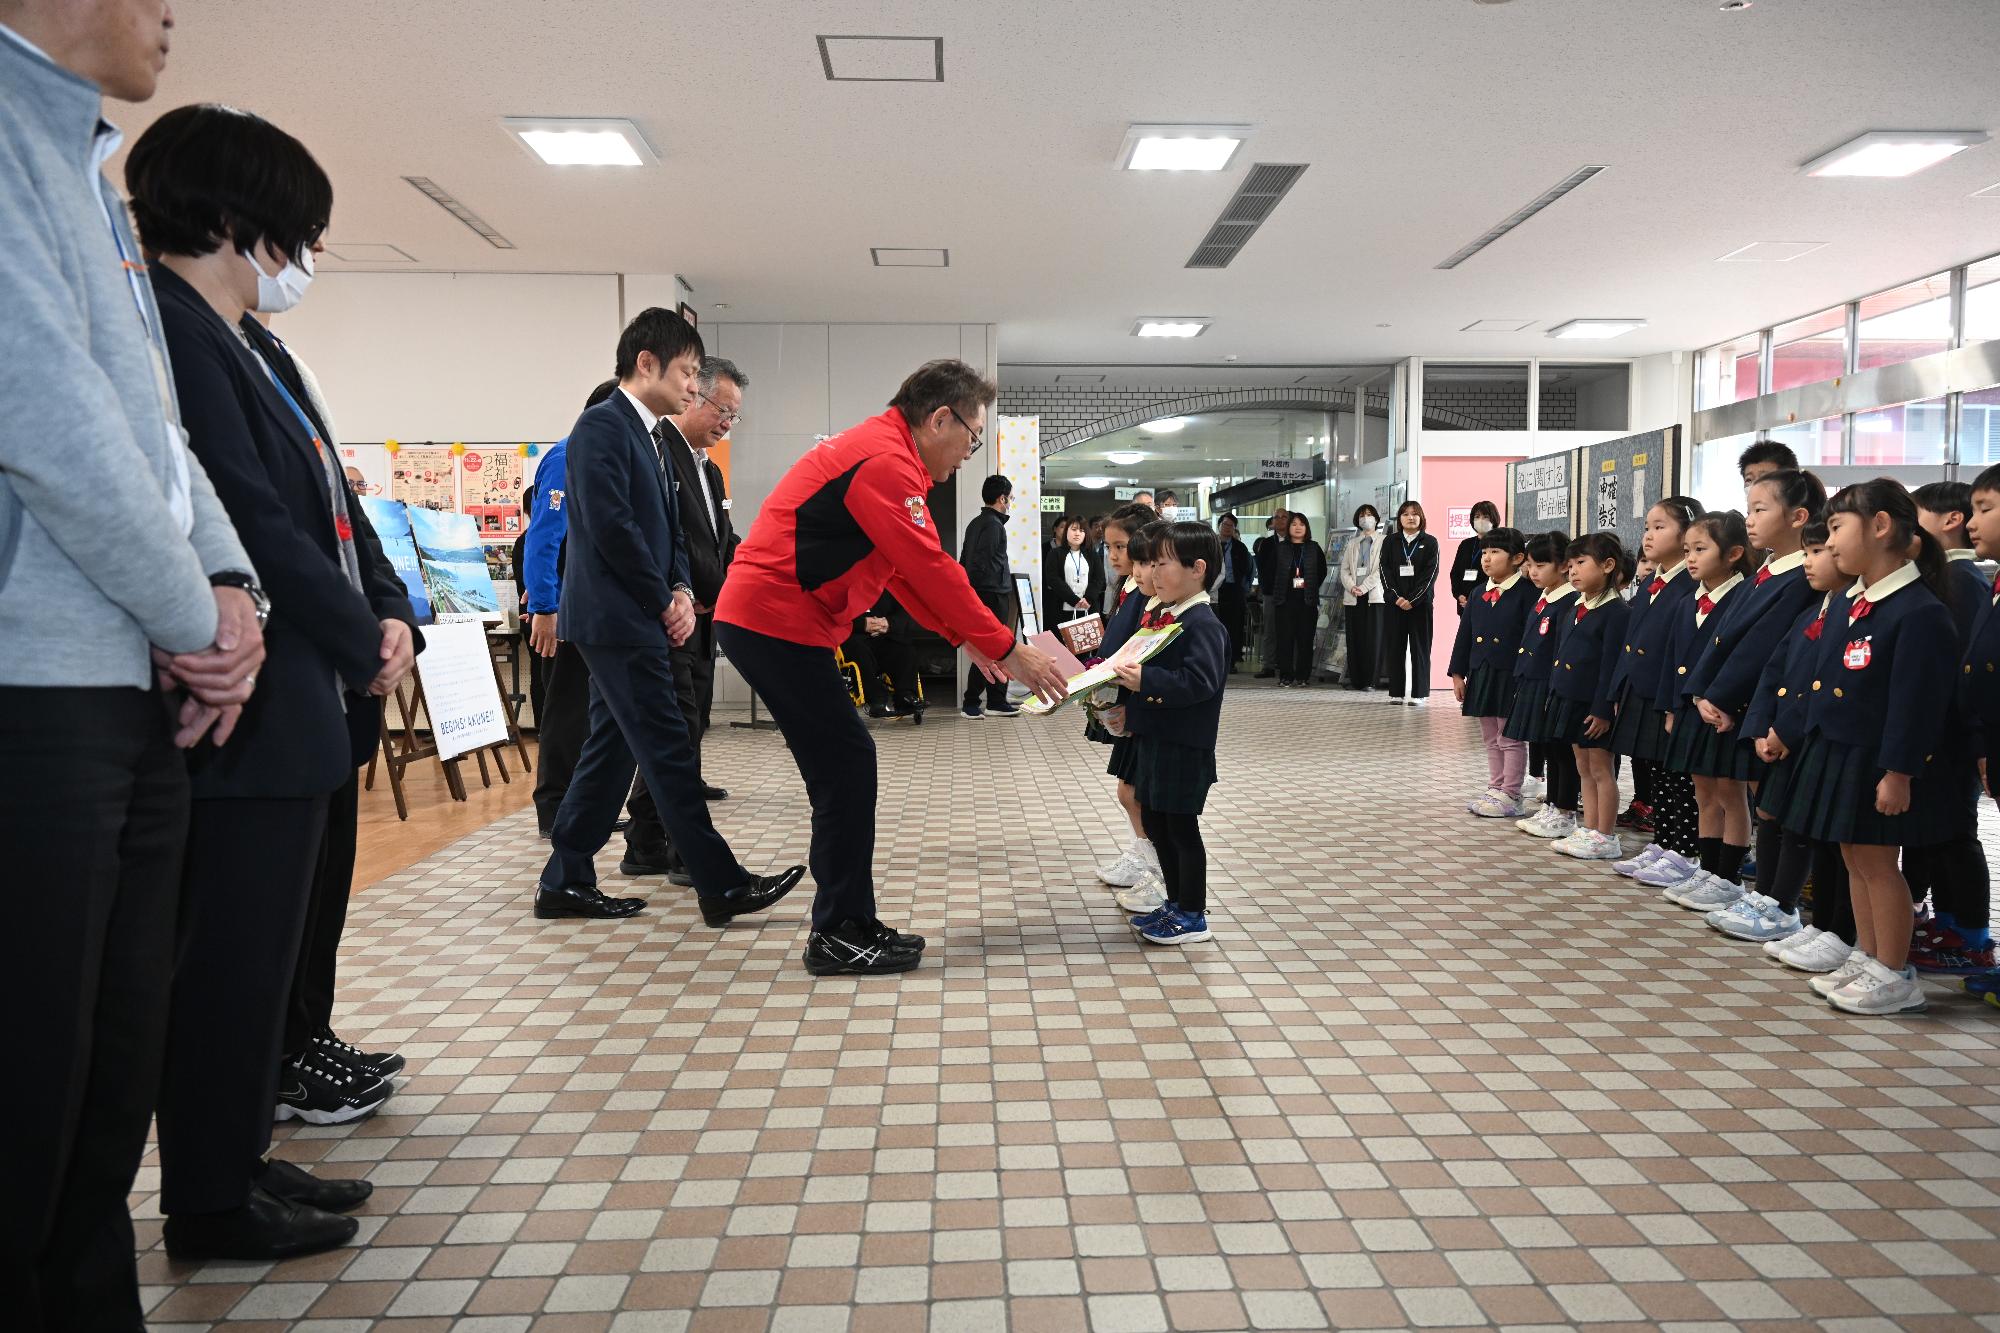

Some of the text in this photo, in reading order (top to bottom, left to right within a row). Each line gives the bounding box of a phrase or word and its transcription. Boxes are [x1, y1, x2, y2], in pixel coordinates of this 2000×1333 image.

[482, 455, 493, 488] つどい
[494, 452, 508, 480] 福祉
[1261, 459, 1290, 468] 阿久根市
[1261, 470, 1313, 479] 消費生活センター
[1518, 465, 1563, 490] 税に関する
[1538, 494, 1567, 517] 作品展
[1599, 477, 1608, 528] 申告
[440, 715, 467, 736] BEGINS!
[467, 709, 495, 727] AKUNE!!
